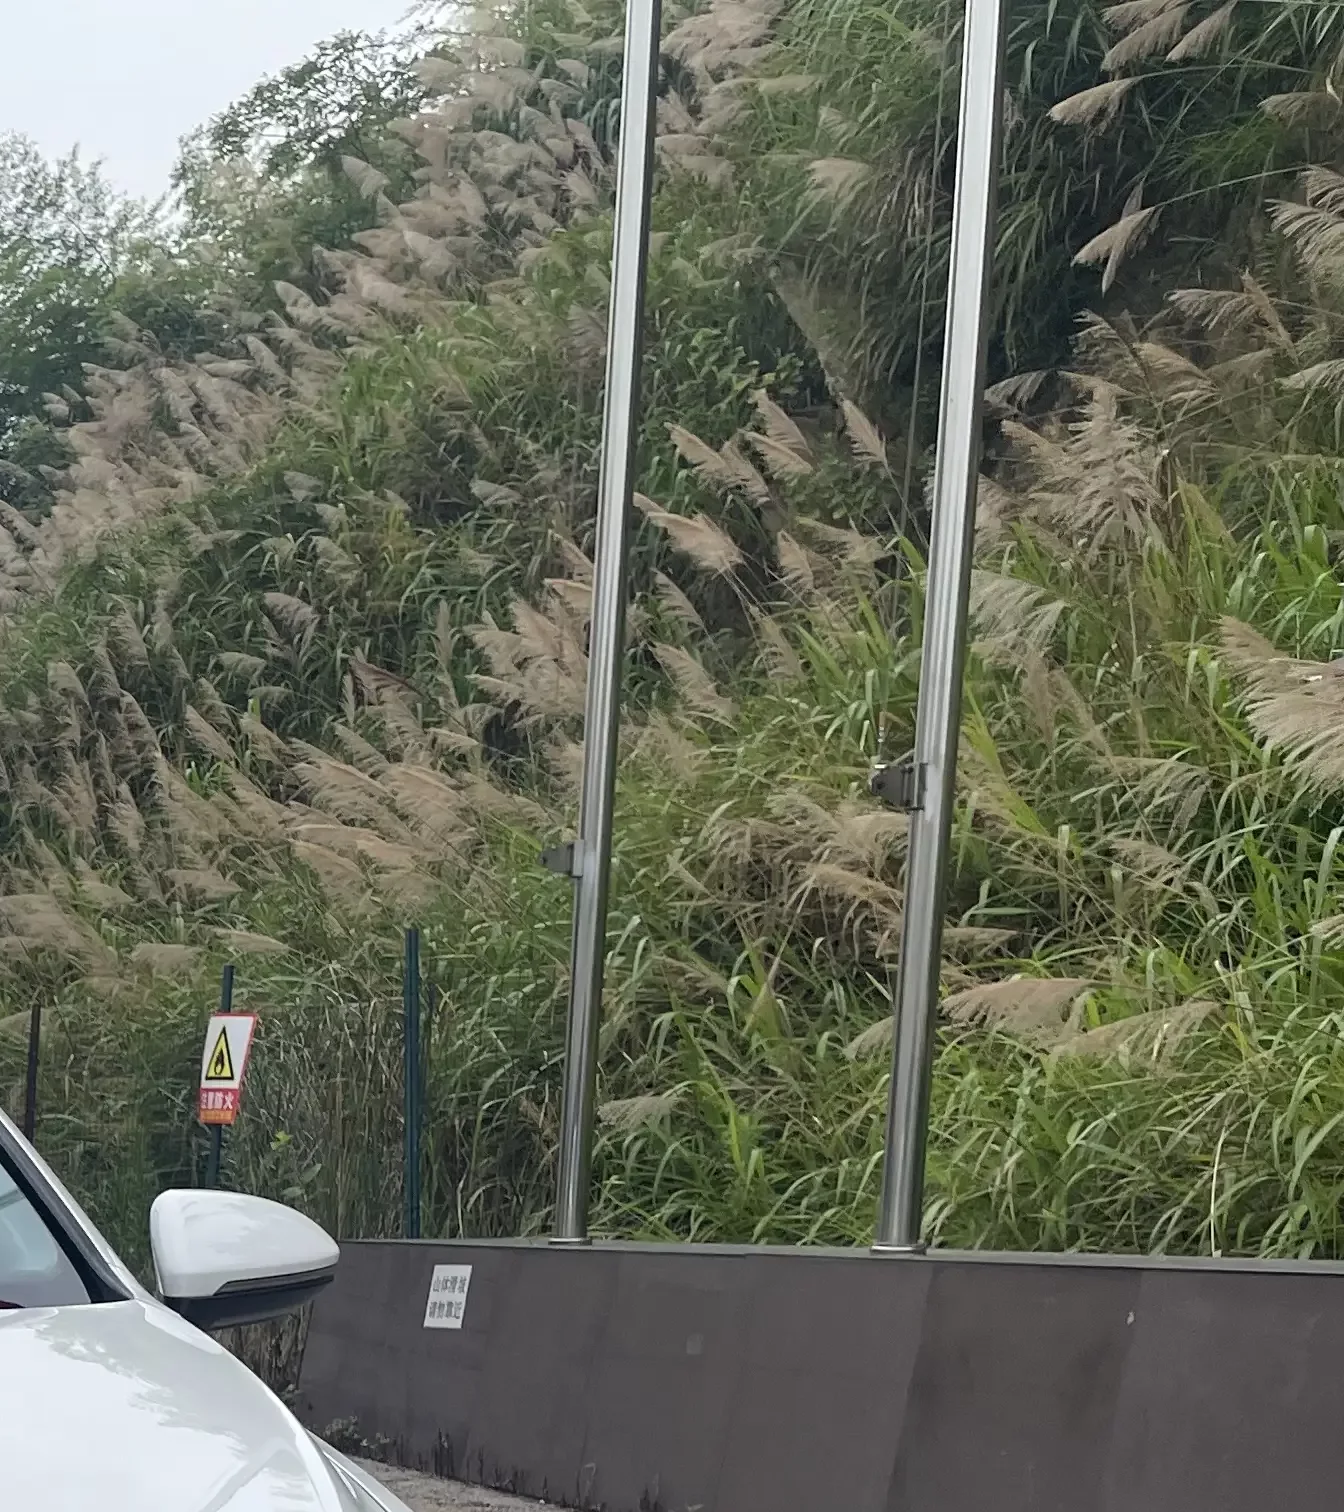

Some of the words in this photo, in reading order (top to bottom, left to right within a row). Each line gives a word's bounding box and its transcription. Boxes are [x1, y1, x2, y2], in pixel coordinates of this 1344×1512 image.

[432, 1275, 467, 1294] 山体滑坡
[428, 1300, 463, 1320] 请勿靠近
